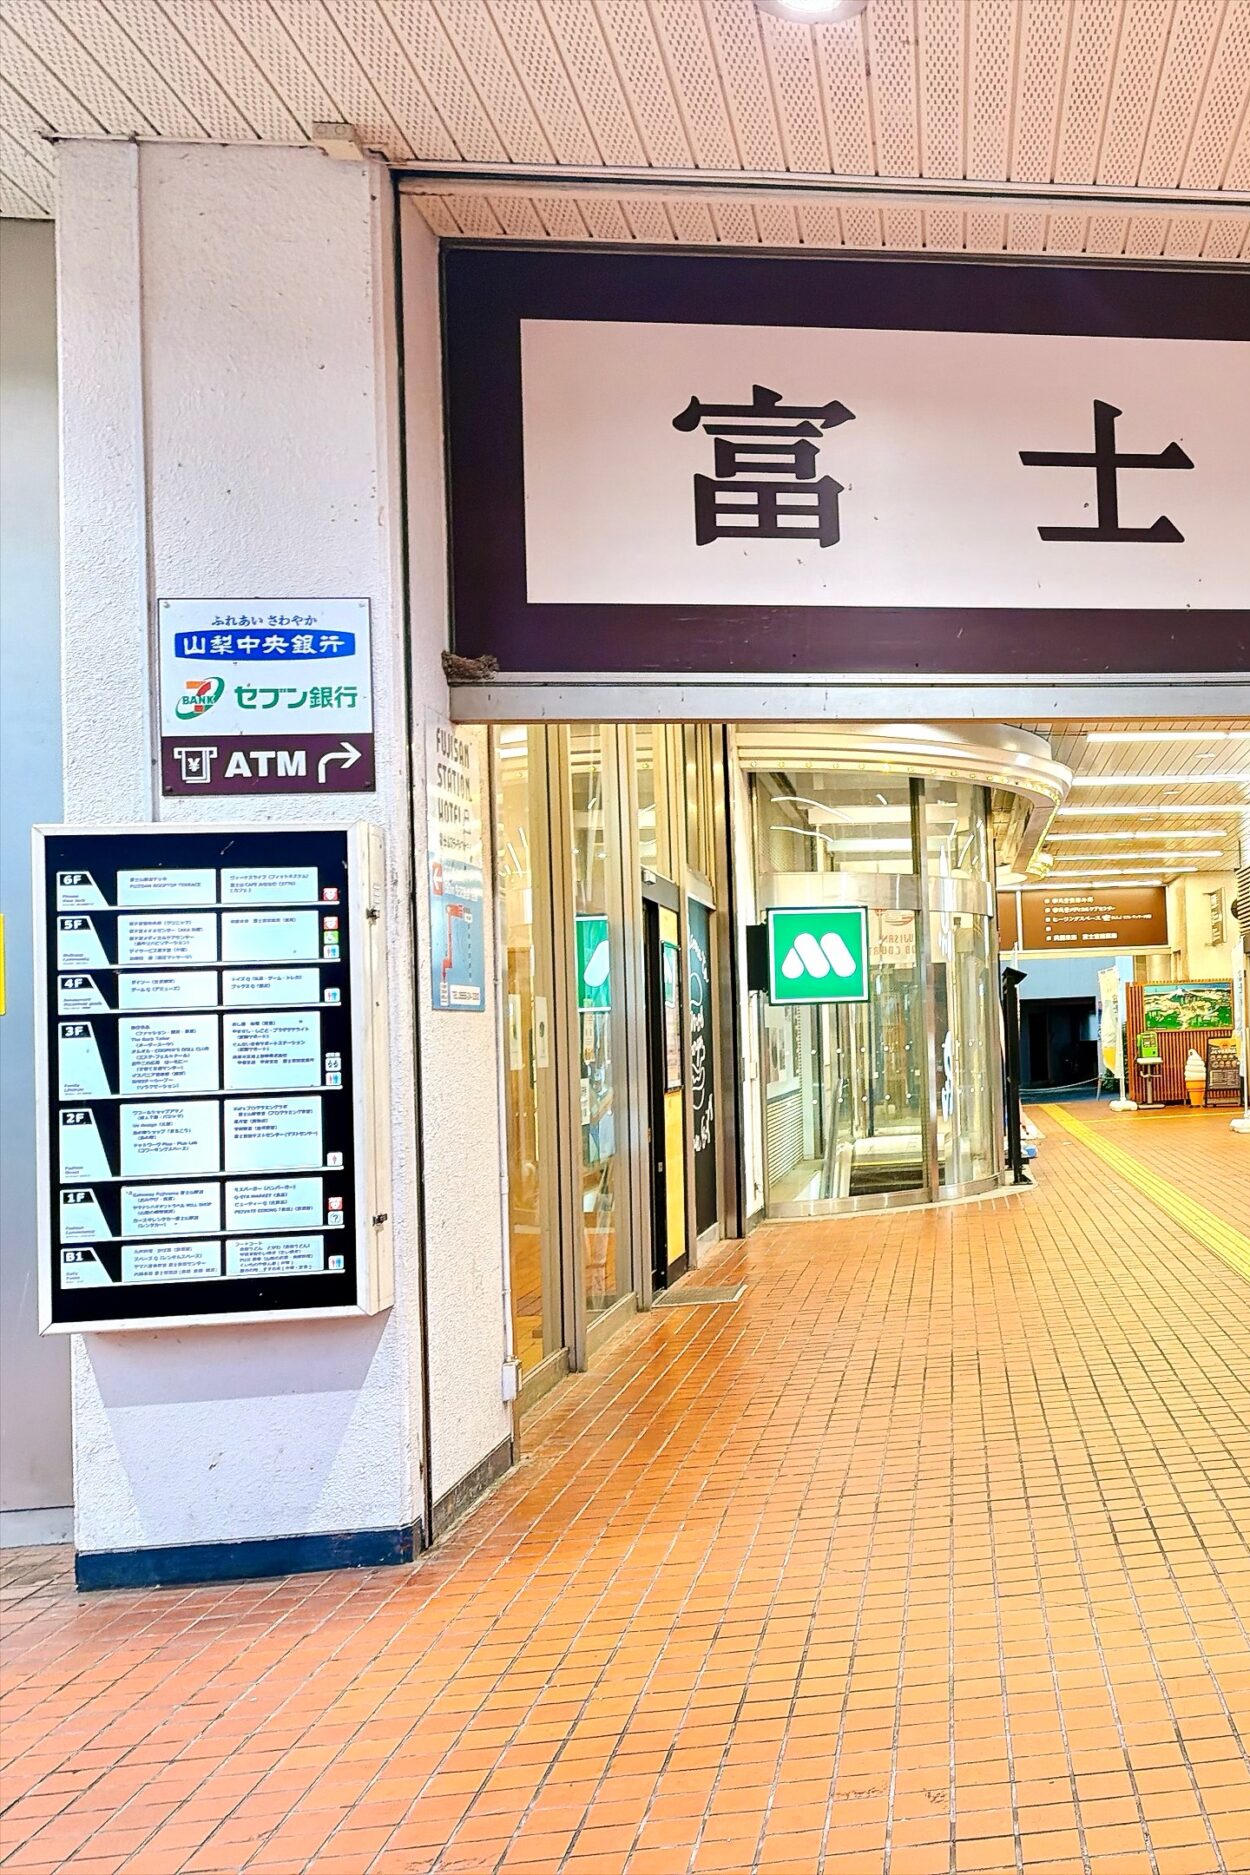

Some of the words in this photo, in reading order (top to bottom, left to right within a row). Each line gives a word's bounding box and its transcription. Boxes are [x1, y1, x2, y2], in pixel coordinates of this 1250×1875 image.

[212, 615, 263, 626] ふれあい
[268, 615, 317, 627] さわやか
[183, 634, 345, 656] 山梨中央銀行
[182, 695, 215, 705] BANK
[234, 686, 357, 709] セブン銀行
[224, 750, 307, 777] ATM
[63, 874, 82, 885] 6F
[64, 920, 82, 930] 5F
[64, 978, 83, 988] 4F
[65, 1026, 84, 1037] 3F
[66, 1113, 85, 1124] 2F
[67, 1193, 85, 1203] 1F
[65, 1252, 84, 1262] B1
